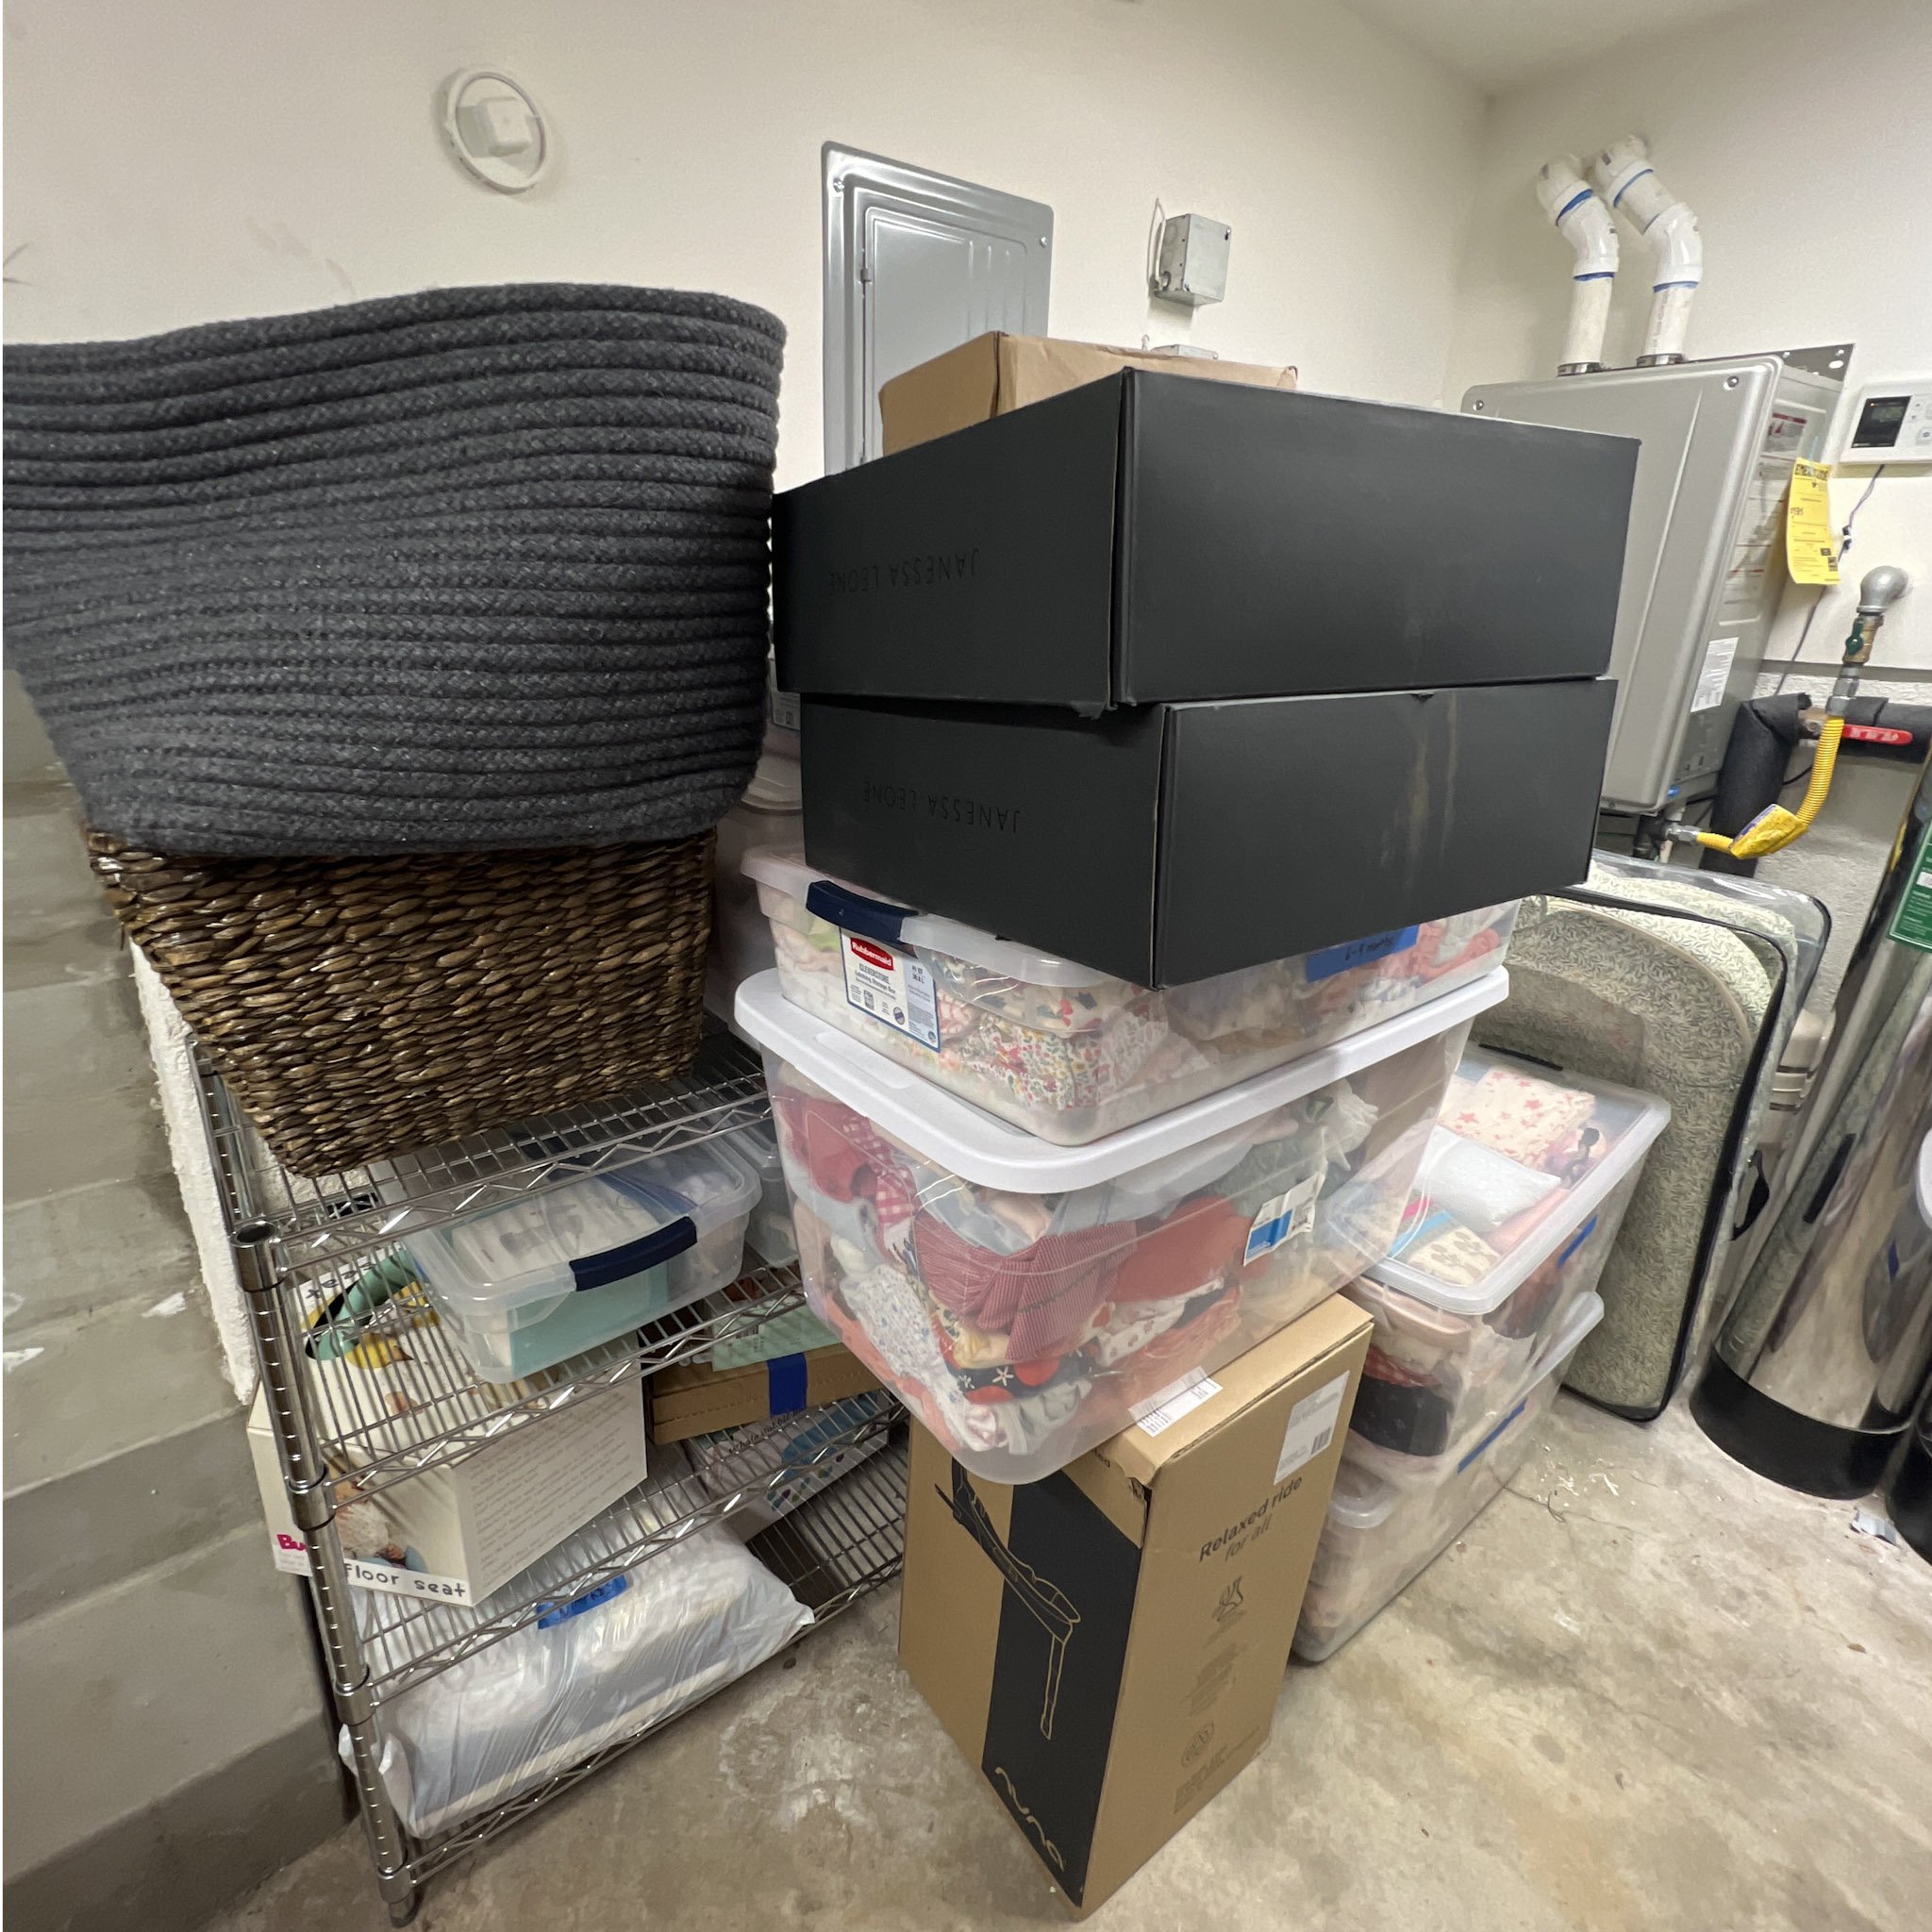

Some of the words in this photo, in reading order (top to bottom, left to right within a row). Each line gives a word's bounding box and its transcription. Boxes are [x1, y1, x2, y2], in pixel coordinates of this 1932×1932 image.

[829, 565, 879, 594] LEONE
[889, 546, 980, 589] JANESSA
[863, 780, 917, 812] LEONE
[927, 794, 1022, 835] JANESSA
[851, 940, 892, 968] Rubbermaid
[1199, 1498, 1270, 1563] Relaxed
[1271, 1476, 1303, 1508] ride
[1224, 1532, 1250, 1563] for
[1251, 1512, 1273, 1541] all
[344, 1562, 400, 1586] floor
[414, 1579, 466, 1598] seat
